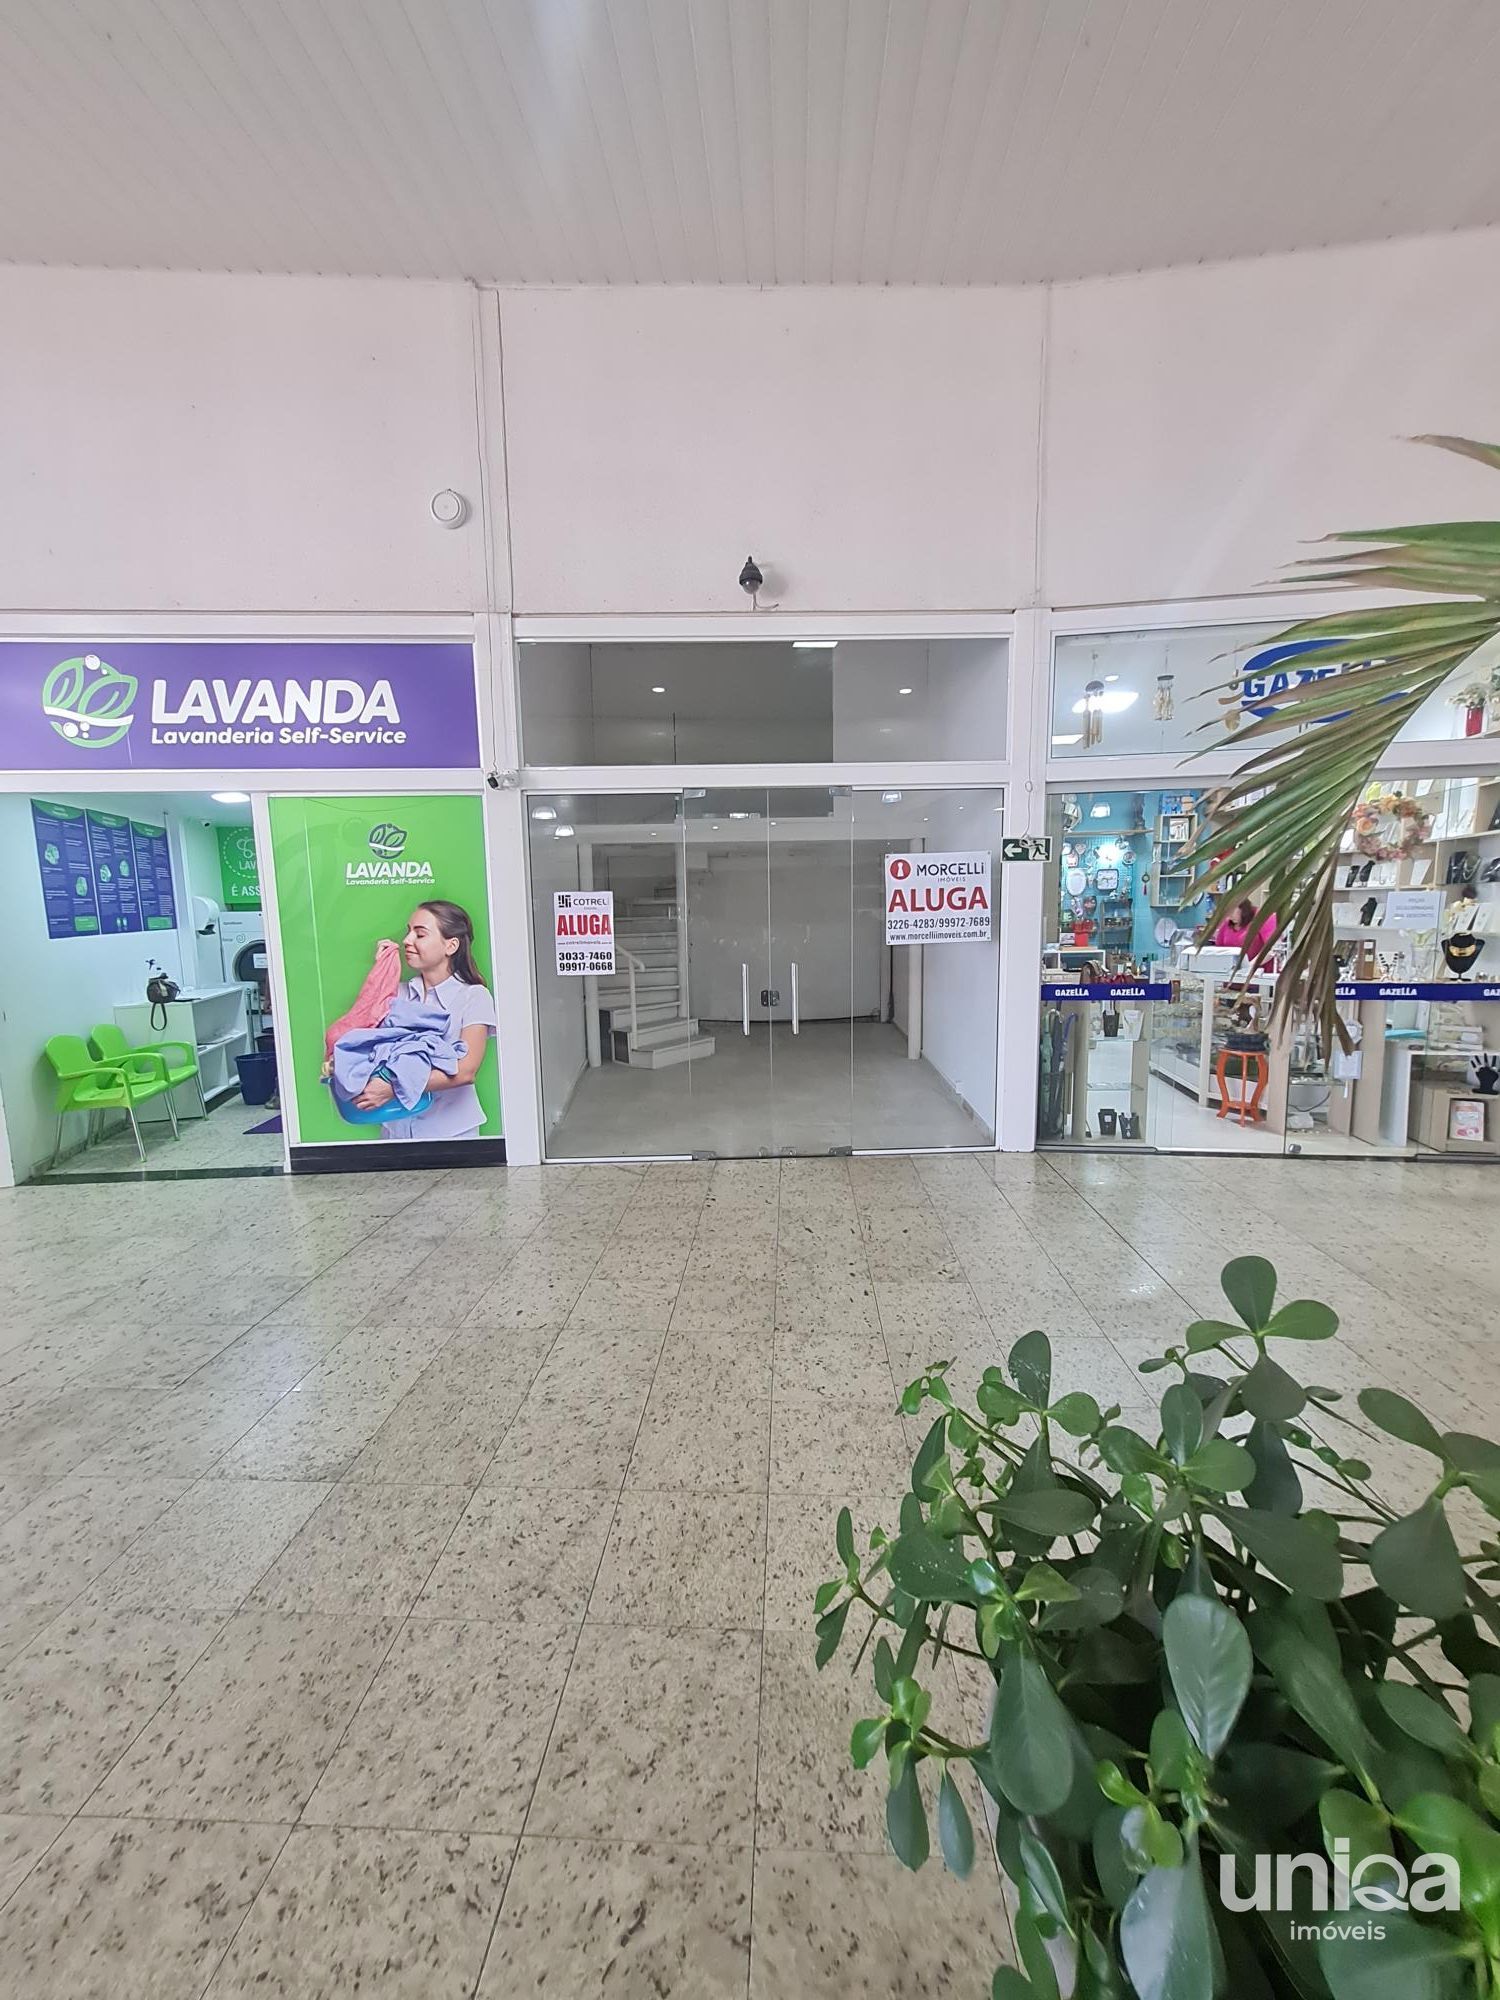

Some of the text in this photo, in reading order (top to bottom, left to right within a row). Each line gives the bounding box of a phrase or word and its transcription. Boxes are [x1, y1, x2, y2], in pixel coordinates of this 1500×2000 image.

[151, 679, 401, 724] LAVANDA
[151, 726, 407, 745] Lavanderia Self-Service
[346, 861, 433, 878] LAVANDA
[231, 883, 239, 896] É
[888, 886, 989, 913] ALUGA
[557, 914, 612, 936] ALUGA
[887, 916, 990, 930] 3226-4283/99972-7689
[889, 929, 987, 941] www.morcelliimoveis.com.br
[558, 952, 612, 961] 3033-7460
[559, 962, 613, 972] 99917-0668
[1055, 987, 1089, 996] GAZELLA
[1110, 987, 1145, 996] GAZELLA
[1379, 988, 1417, 996] GAZELLA
